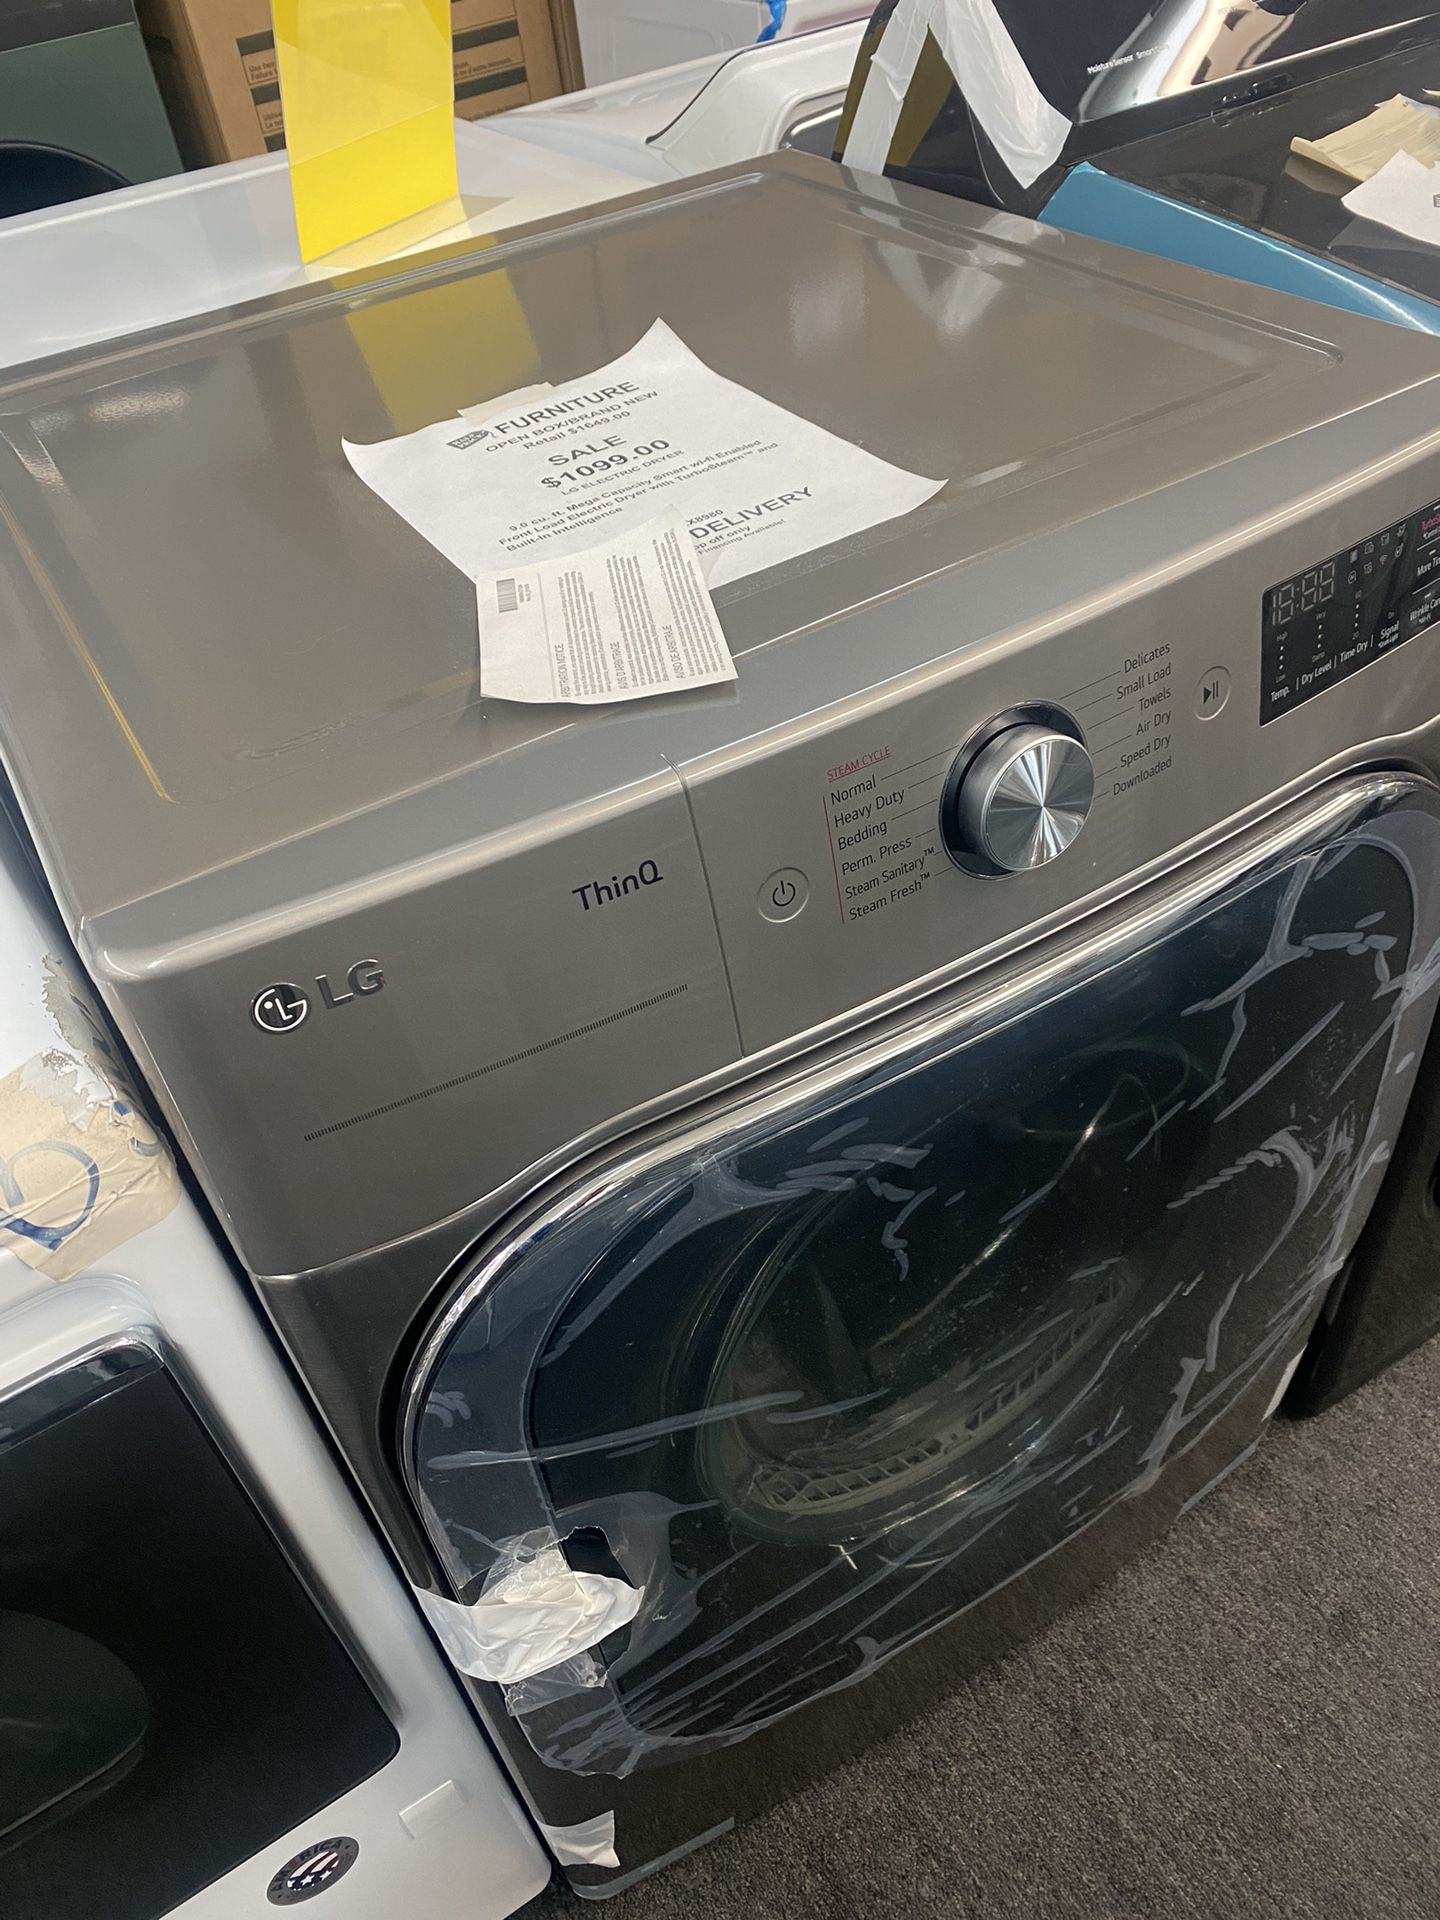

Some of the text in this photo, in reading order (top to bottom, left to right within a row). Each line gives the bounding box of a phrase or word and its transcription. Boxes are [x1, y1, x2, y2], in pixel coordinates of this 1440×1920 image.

[1086, 60, 1113, 74] Moisture
[1113, 54, 1134, 66] Sensor
[486, 433, 529, 452] OPEN
[532, 404, 621, 437] BOX/BRAND
[624, 391, 658, 406] NEW
[494, 381, 640, 434] FURNITURE
[523, 411, 631, 449] Retail $1649.00
[540, 439, 670, 488] $1099.00
[548, 434, 627, 465] SALE
[508, 522, 528, 532] 9.0
[531, 516, 551, 525] cu.
[551, 510, 566, 518] ft.
[566, 497, 600, 512] Mega
[601, 479, 652, 498] Capacity
[653, 465, 689, 481] Smart
[716, 440, 761, 458] Enabled
[561, 450, 684, 495] LG ELECTRIC DRYER
[499, 530, 533, 545] Front
[533, 518, 565, 533] Load
[567, 501, 613, 520] Electric
[614, 489, 647, 503] Dryer
[648, 479, 675, 490] with
[757, 442, 779, 454] and
[506, 506, 623, 552] Built-In Intelligence
[686, 509, 724, 526] X8980
[689, 486, 812, 539] DELIVERY
[709, 534, 725, 544] off
[726, 525, 751, 537] only
[1416, 562, 1432, 577] More
[1380, 620, 1400, 639] Signal
[1124, 642, 1171, 674] Delicates
[1340, 640, 1369, 662] Time Dry
[1116, 662, 1172, 700] Small Load
[1301, 659, 1332, 685] Dry Level
[1138, 686, 1172, 712] Towels
[1270, 686, 1290, 702] Temp.
[1136, 710, 1172, 736] Air Dry
[826, 745, 891, 782] STEAM CYCLE
[1120, 734, 1172, 769] Speed Dry
[830, 774, 877, 806] Normal
[1113, 755, 1172, 796] Downloaded
[834, 789, 906, 828] Heavy Duty
[838, 820, 888, 851] Bedding
[841, 837, 912, 876] Perm. Press
[571, 858, 664, 912] ThinQ
[845, 877, 880, 900] Steam
[849, 896, 888, 921] Steam
[314, 957, 387, 1010] LG
[270, 1839, 343, 1892] AMRICA
